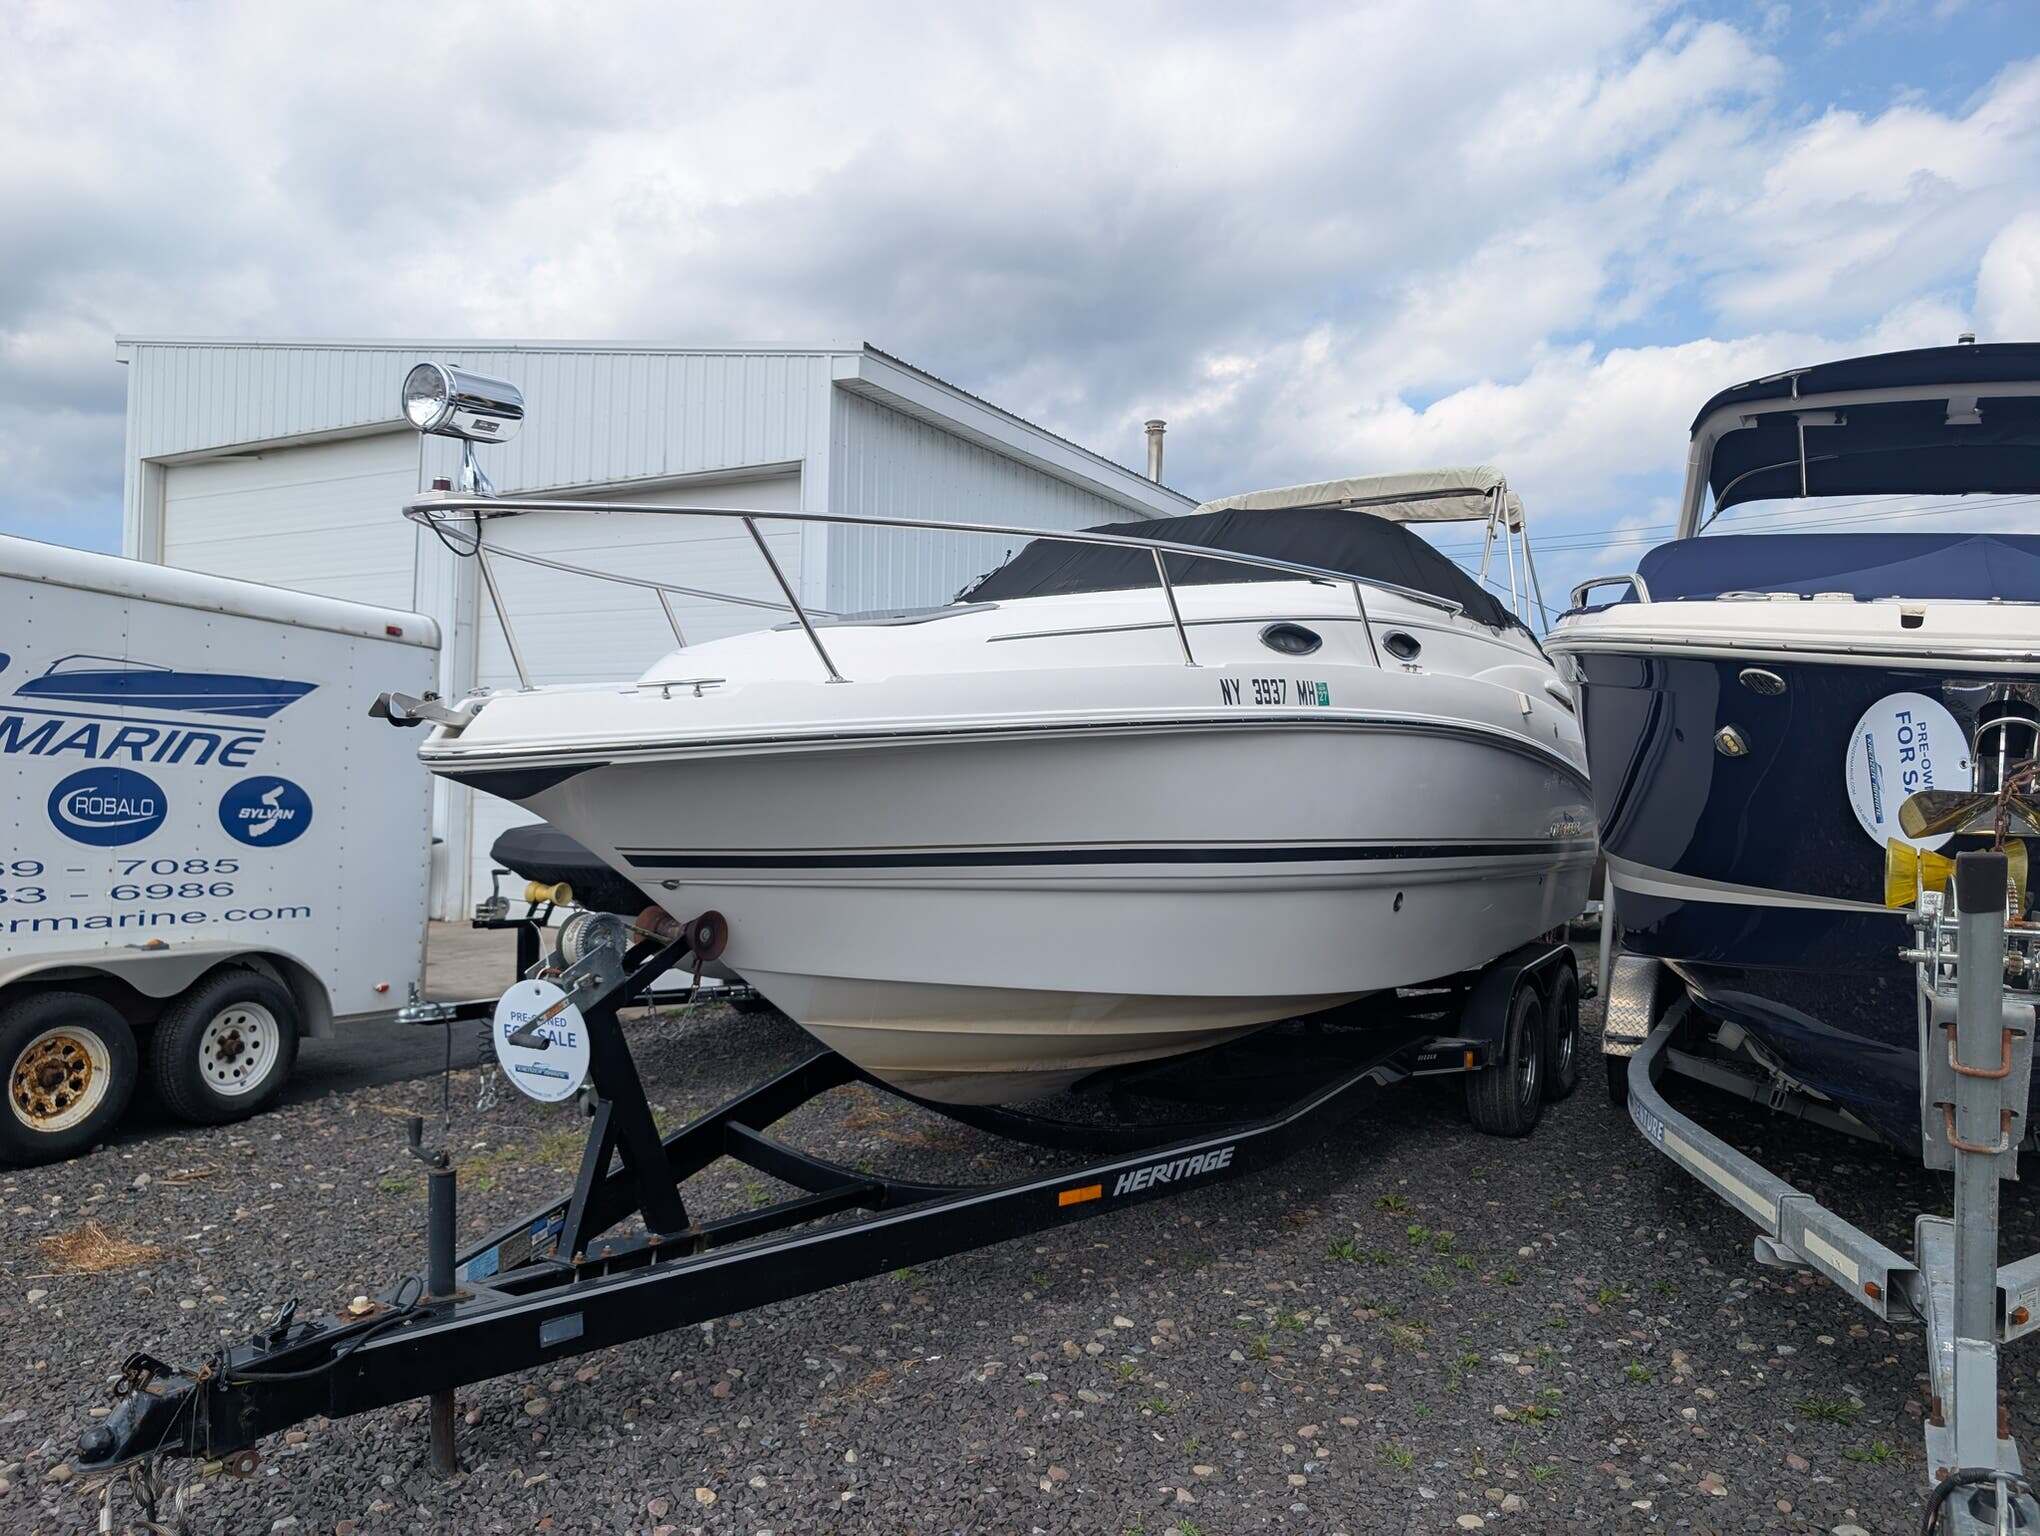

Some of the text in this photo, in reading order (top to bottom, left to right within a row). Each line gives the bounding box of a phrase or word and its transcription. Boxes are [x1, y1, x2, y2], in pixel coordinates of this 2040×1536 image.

[1219, 678, 1316, 706] NY 3937 MH
[0, 716, 264, 767] MARINE
[1895, 710, 1916, 764] FOR
[1916, 721, 1934, 790] PRE-OW
[75, 796, 154, 816] ROBALO
[238, 808, 295, 820] SYLVAN
[0, 860, 44, 878] 9
[117, 858, 239, 876] 7085
[0, 886, 47, 904] 3
[110, 881, 234, 901] 6986
[0, 905, 311, 933] rmarine.com
[510, 1011, 567, 1028] PRE-NED
[1113, 1146, 1235, 1196] HERITAGE
